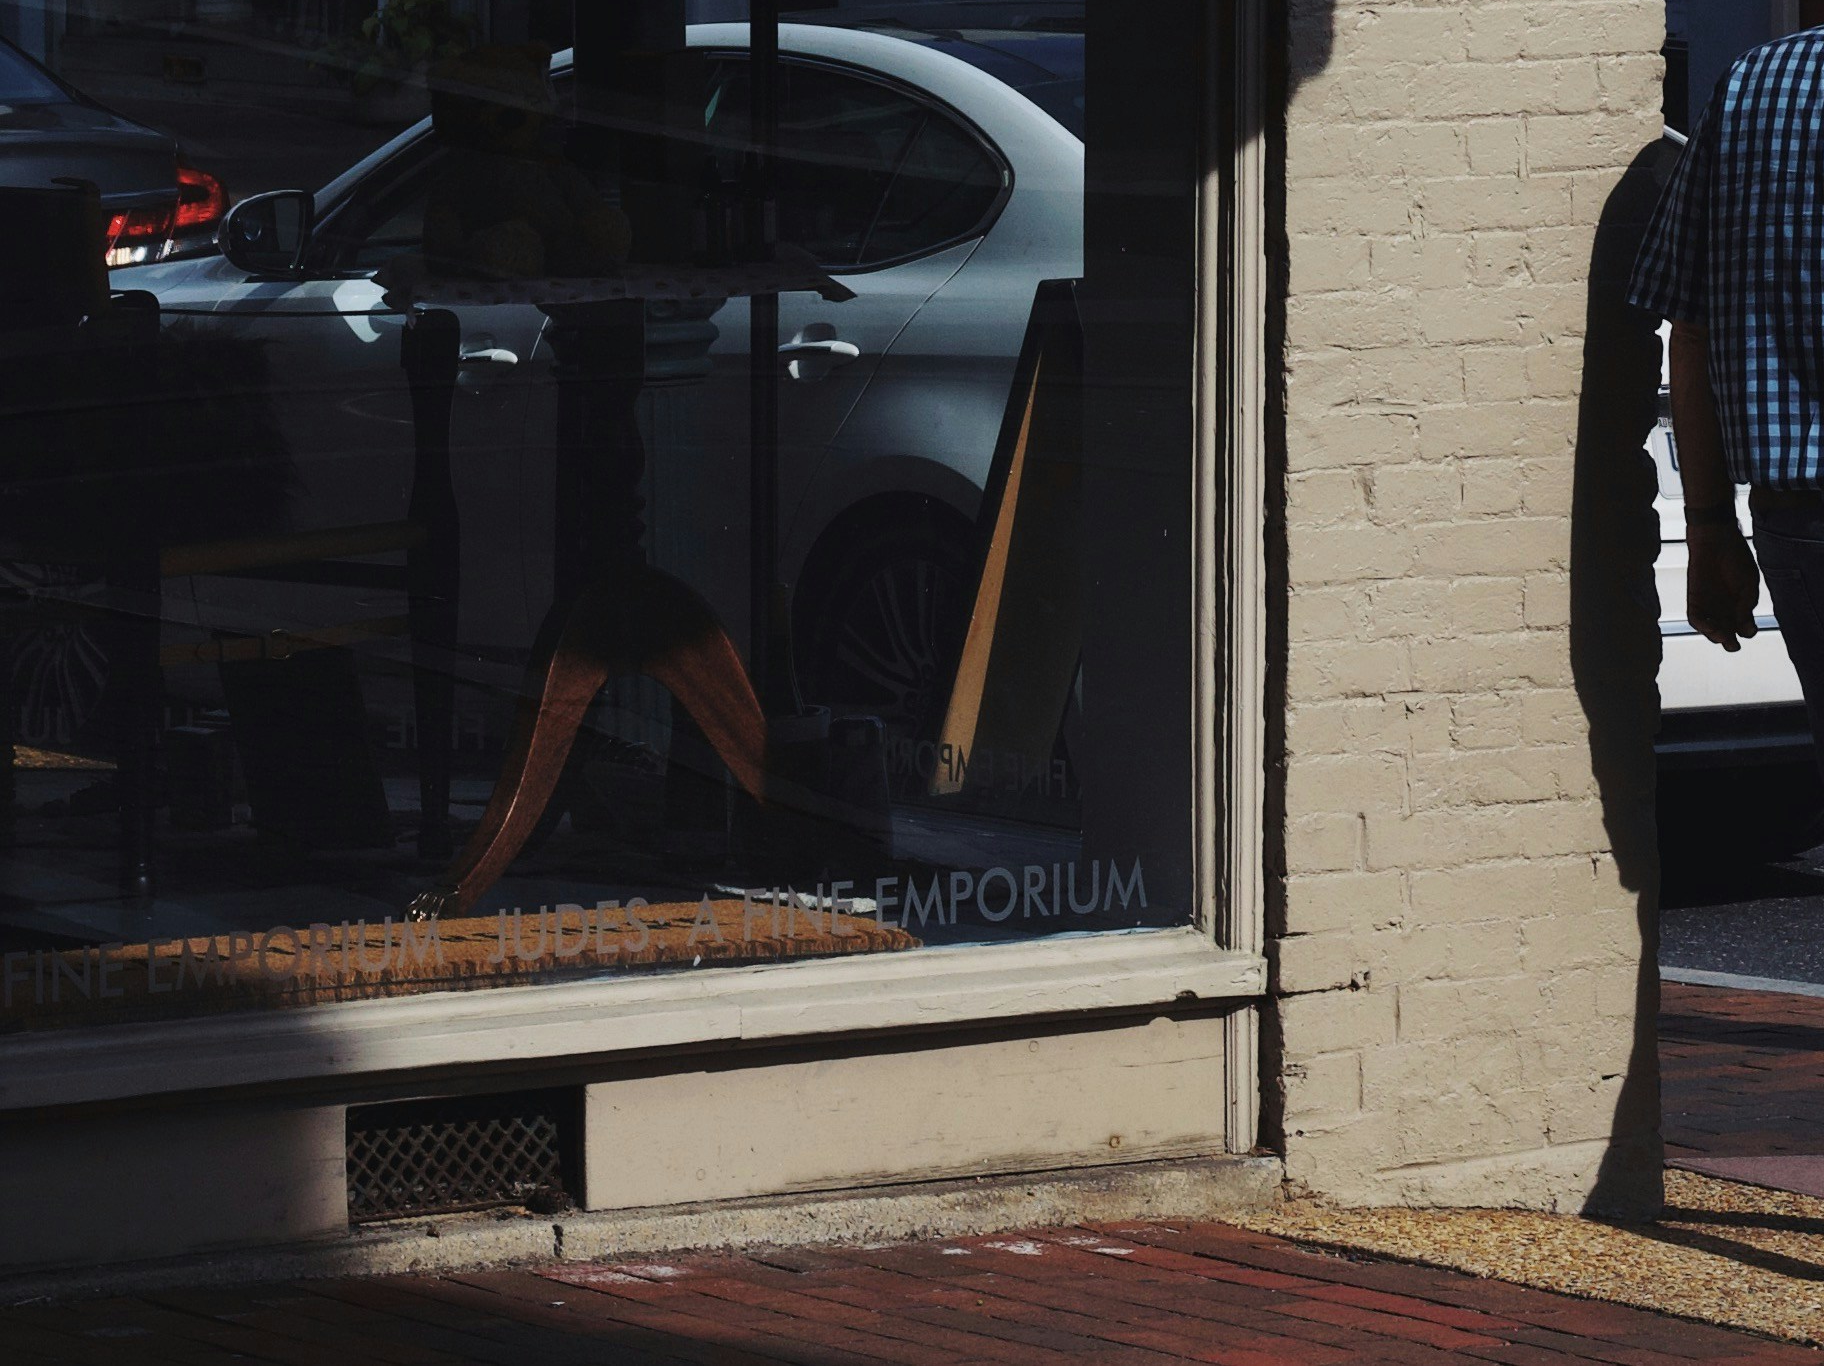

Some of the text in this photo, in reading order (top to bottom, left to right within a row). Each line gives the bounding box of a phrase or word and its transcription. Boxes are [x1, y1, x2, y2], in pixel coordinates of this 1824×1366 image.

[688, 892, 724, 947] A
[743, 880, 855, 942] FINE
[876, 855, 1148, 931] EMPORIUM
[4, 914, 444, 1009] FINE EMPORIUM
